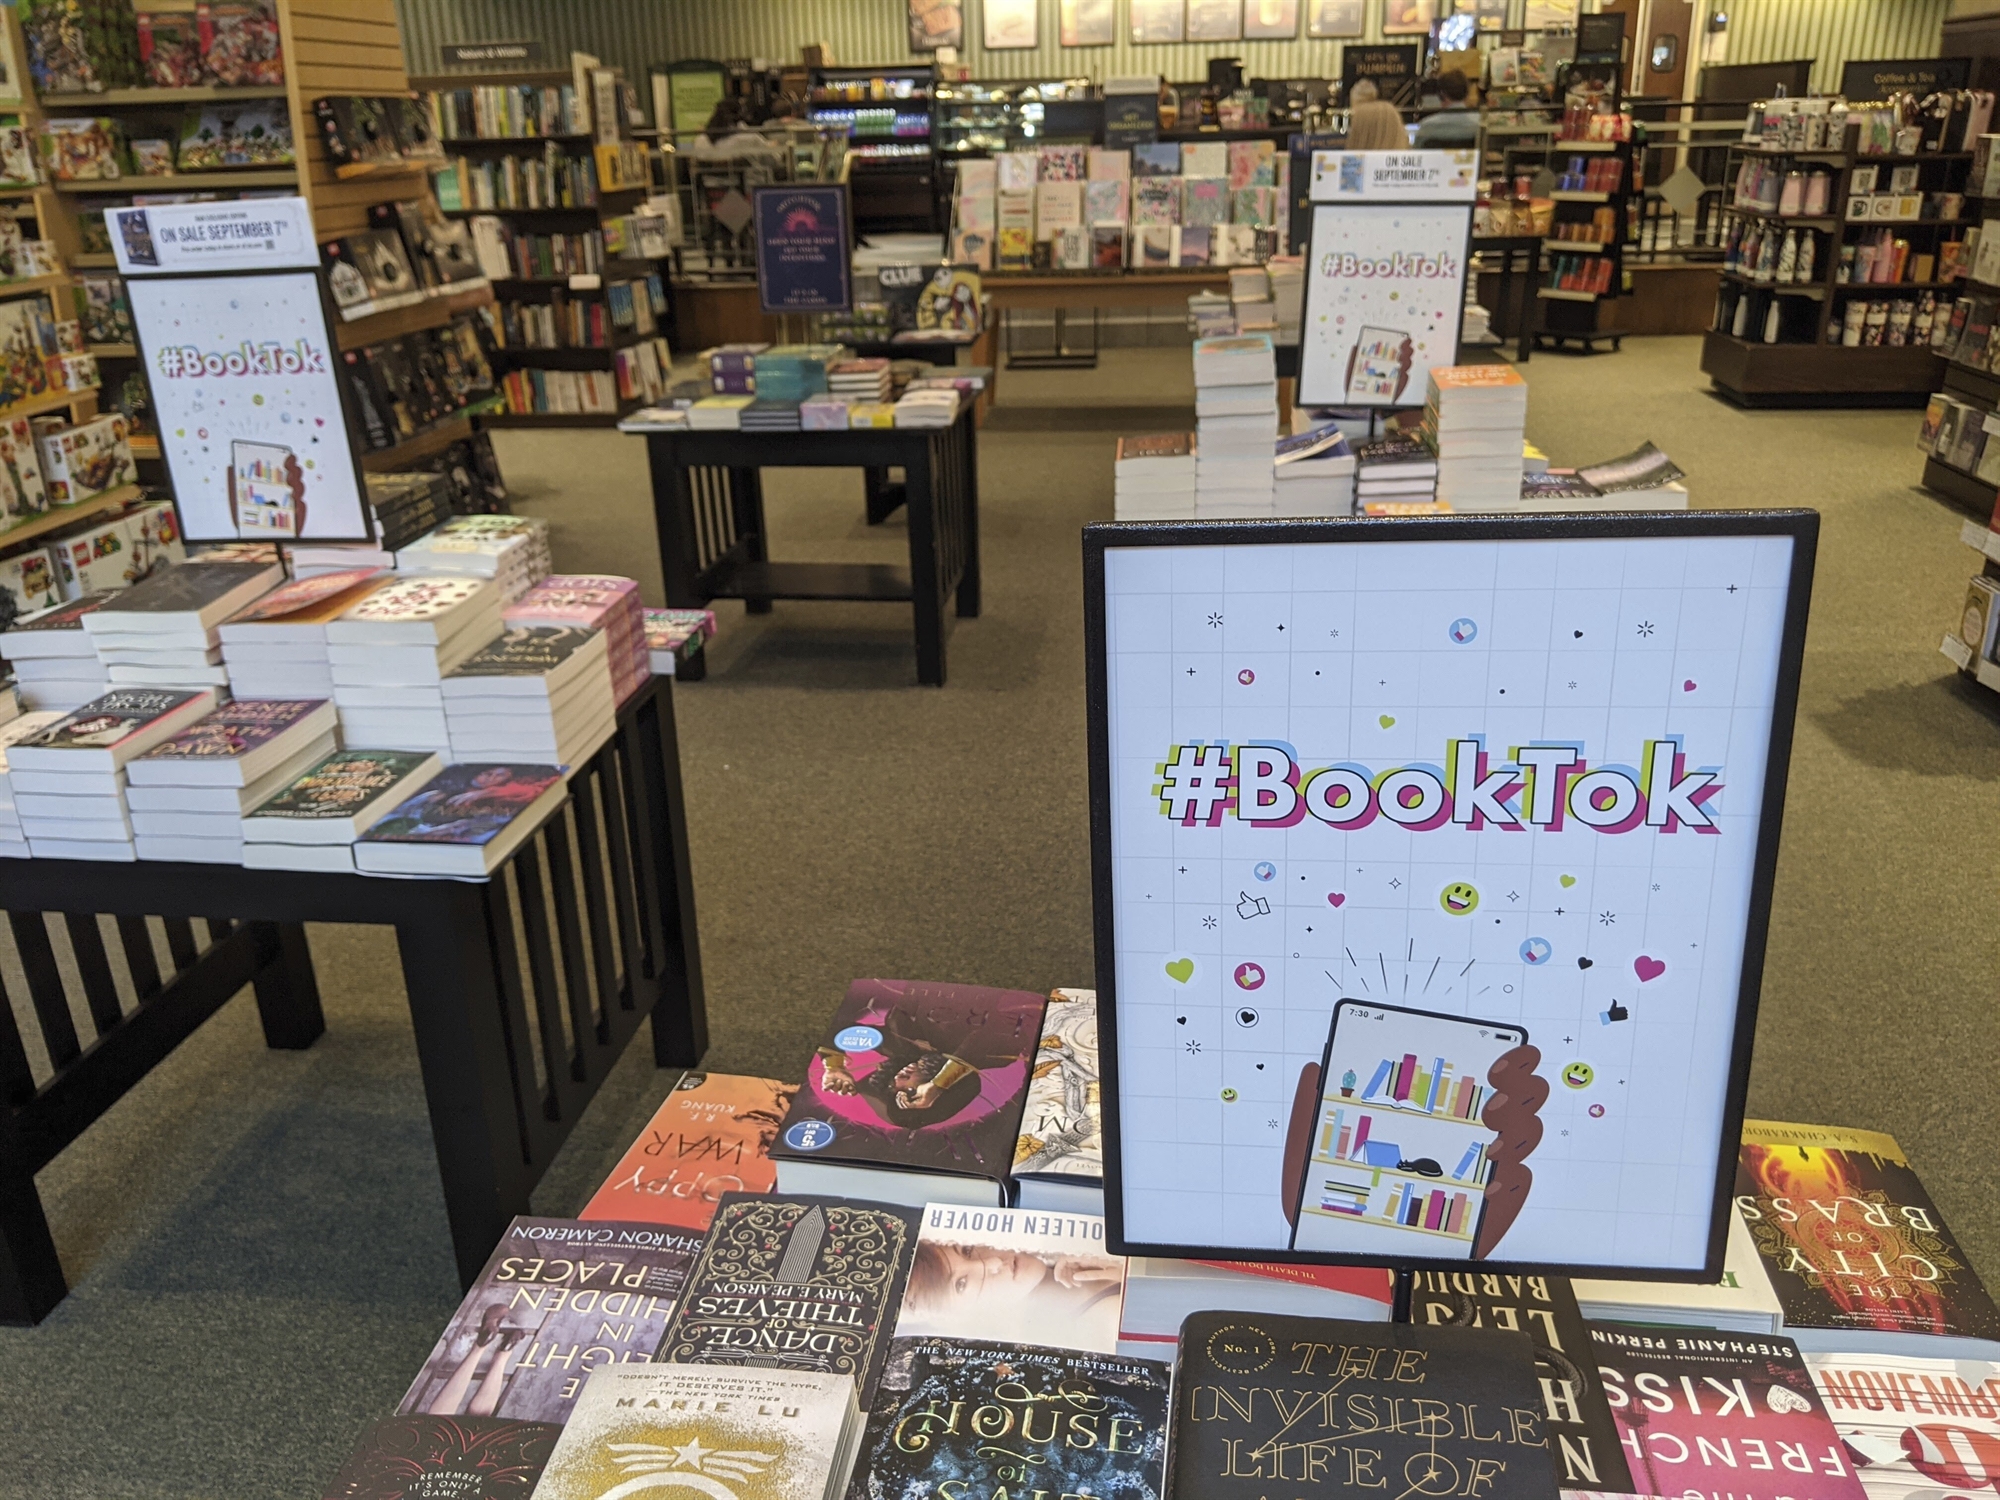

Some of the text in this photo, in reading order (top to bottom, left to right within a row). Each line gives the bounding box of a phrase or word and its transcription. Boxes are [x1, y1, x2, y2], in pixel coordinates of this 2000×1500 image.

[1385, 155, 1423, 168] ON SALE
[1373, 169, 1426, 182] SEPTEMBER
[160, 228, 178, 244] ON
[179, 225, 206, 243] SALE
[207, 222, 272, 242] SEPTEMBER
[1321, 251, 1457, 279] #BookTok
[879, 266, 924, 288] CLUE
[158, 339, 326, 379] #BookTok
[1151, 733, 1726, 835] #BookTok
[1349, 1008, 1369, 1018] 7:30
[859, 1037, 873, 1046] YA
[680, 1100, 736, 1113] KUANG
[689, 1110, 716, 1122] R. F.
[644, 1130, 744, 1166] WAR
[801, 1134, 816, 1147] $5
[613, 1166, 775, 1202] OPPY
[930, 1209, 1015, 1233] HOOVER
[1736, 1195, 1940, 1233] BRASS
[510, 1226, 703, 1253] SHARON CAMERON
[1832, 1232, 1863, 1243] OF
[496, 1257, 649, 1289] PLACES
[1248, 1262, 1264, 1271] DO
[1266, 1265, 1298, 1276] DEATH
[1784, 1247, 1939, 1282] CITY
[1300, 1271, 1316, 1280] TIL
[711, 1282, 794, 1297] PEARSON
[795, 1286, 810, 1298] E.
[814, 1288, 864, 1304] MARY
[1849, 1284, 1903, 1298] THE
[508, 1286, 678, 1324] HIDDEN
[696, 1296, 864, 1327] THIEVES
[596, 1322, 635, 1342] IN
[765, 1318, 788, 1329] OF
[1248, 1326, 1266, 1336] NEW
[706, 1326, 838, 1354] DANCE
[1208, 1324, 1236, 1344] AUTHOR
[1224, 1344, 1260, 1354] No. 1
[1626, 1351, 1671, 1360] BESTSELLER
[1675, 1354, 1738, 1364] INTERNATIONAL
[1677, 1338, 1794, 1358] STEPHANIE
[914, 1346, 1150, 1376] THE NEW YORK TIMES BESTSELLER
[1254, 1358, 1274, 1372] TIMES
[1291, 1342, 1429, 1384] THE
[672, 1374, 712, 1382] MERELY
[716, 1378, 762, 1386] SURVIVE
[790, 1383, 822, 1392] HYPE,
[676, 1382, 744, 1392] DESERVES
[1598, 1366, 1756, 1418] KISS
[714, 1392, 742, 1400] YORK
[615, 1398, 801, 1418] MARIE LU
[1191, 1386, 1550, 1450] INVISIBLE
[893, 1386, 1144, 1455] HOUSE
[420, 1470, 483, 1486] REMEMBER,
[997, 1463, 1028, 1484] of
[1220, 1438, 1387, 1490] LIFE
[1404, 1452, 1506, 1499] OF
[408, 1480, 482, 1495] IT'S ONLY A
